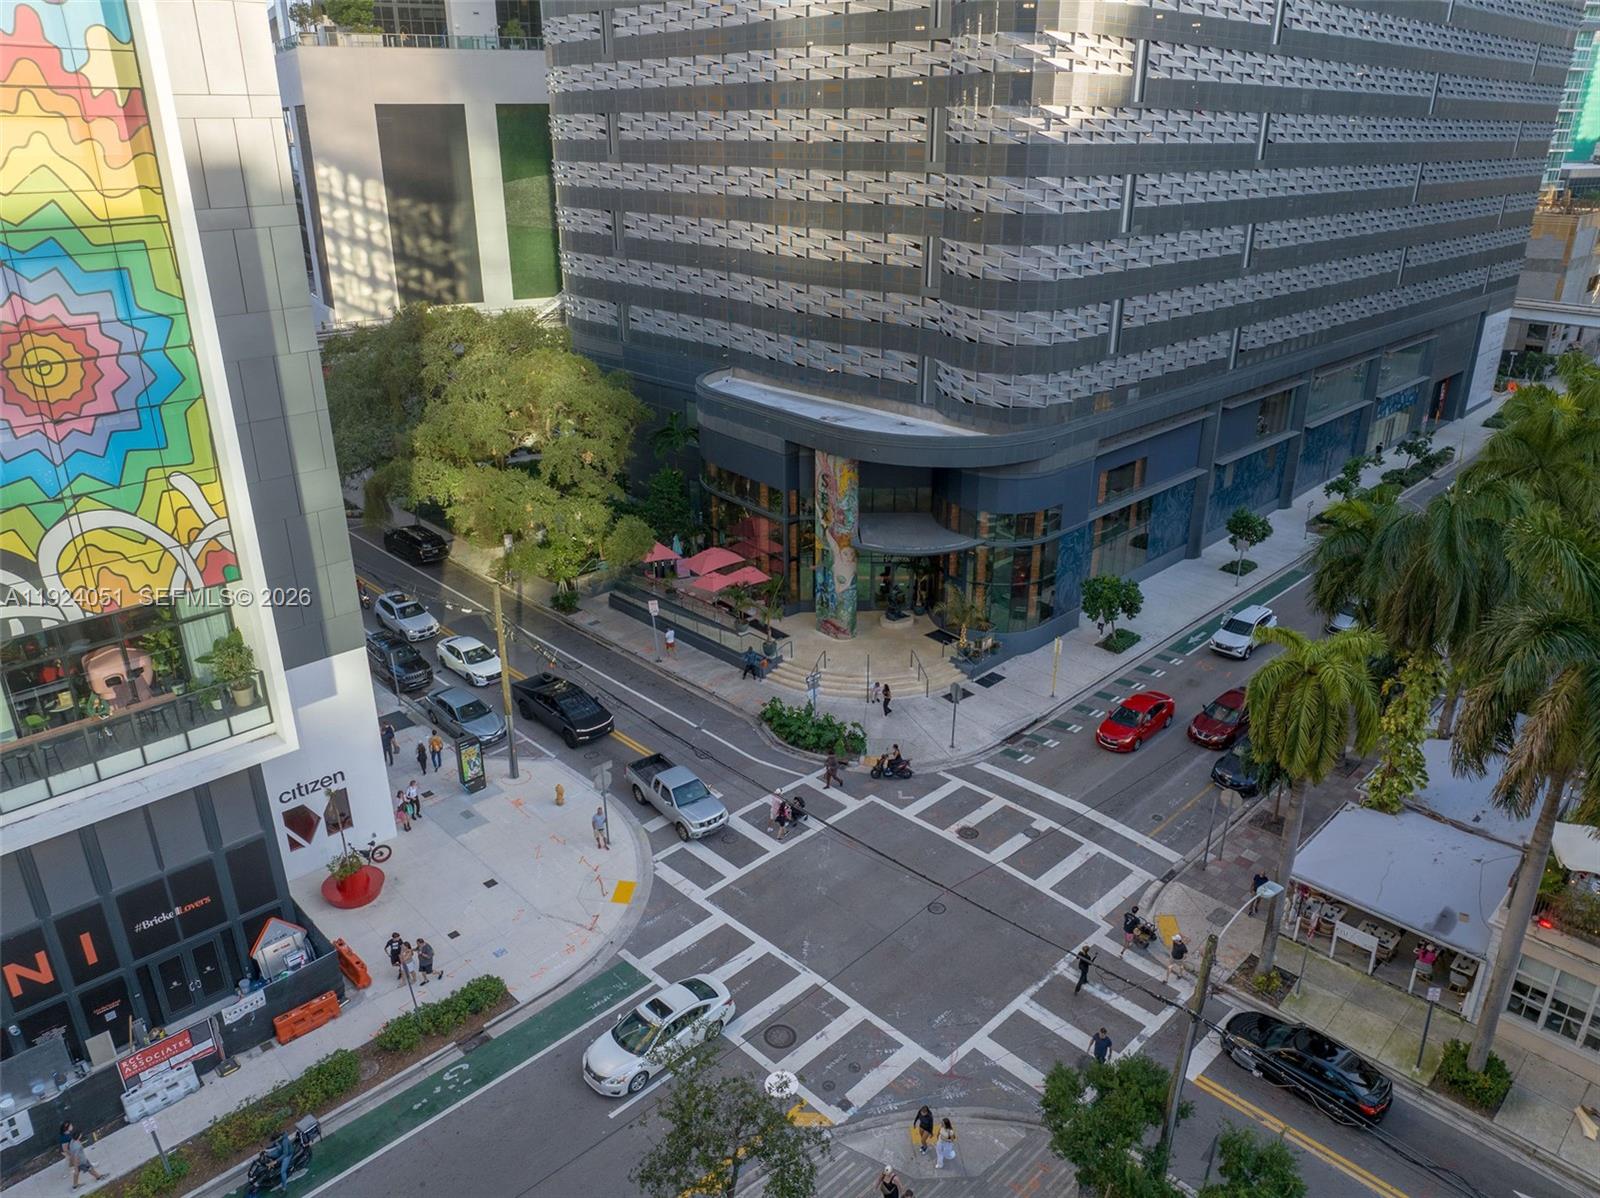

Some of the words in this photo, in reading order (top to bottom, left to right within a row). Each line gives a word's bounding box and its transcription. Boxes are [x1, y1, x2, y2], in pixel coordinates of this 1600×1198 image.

[279, 771, 345, 804] citizen
[121, 1052, 143, 1068] RCC
[125, 1037, 191, 1073] ASSOCIATES
